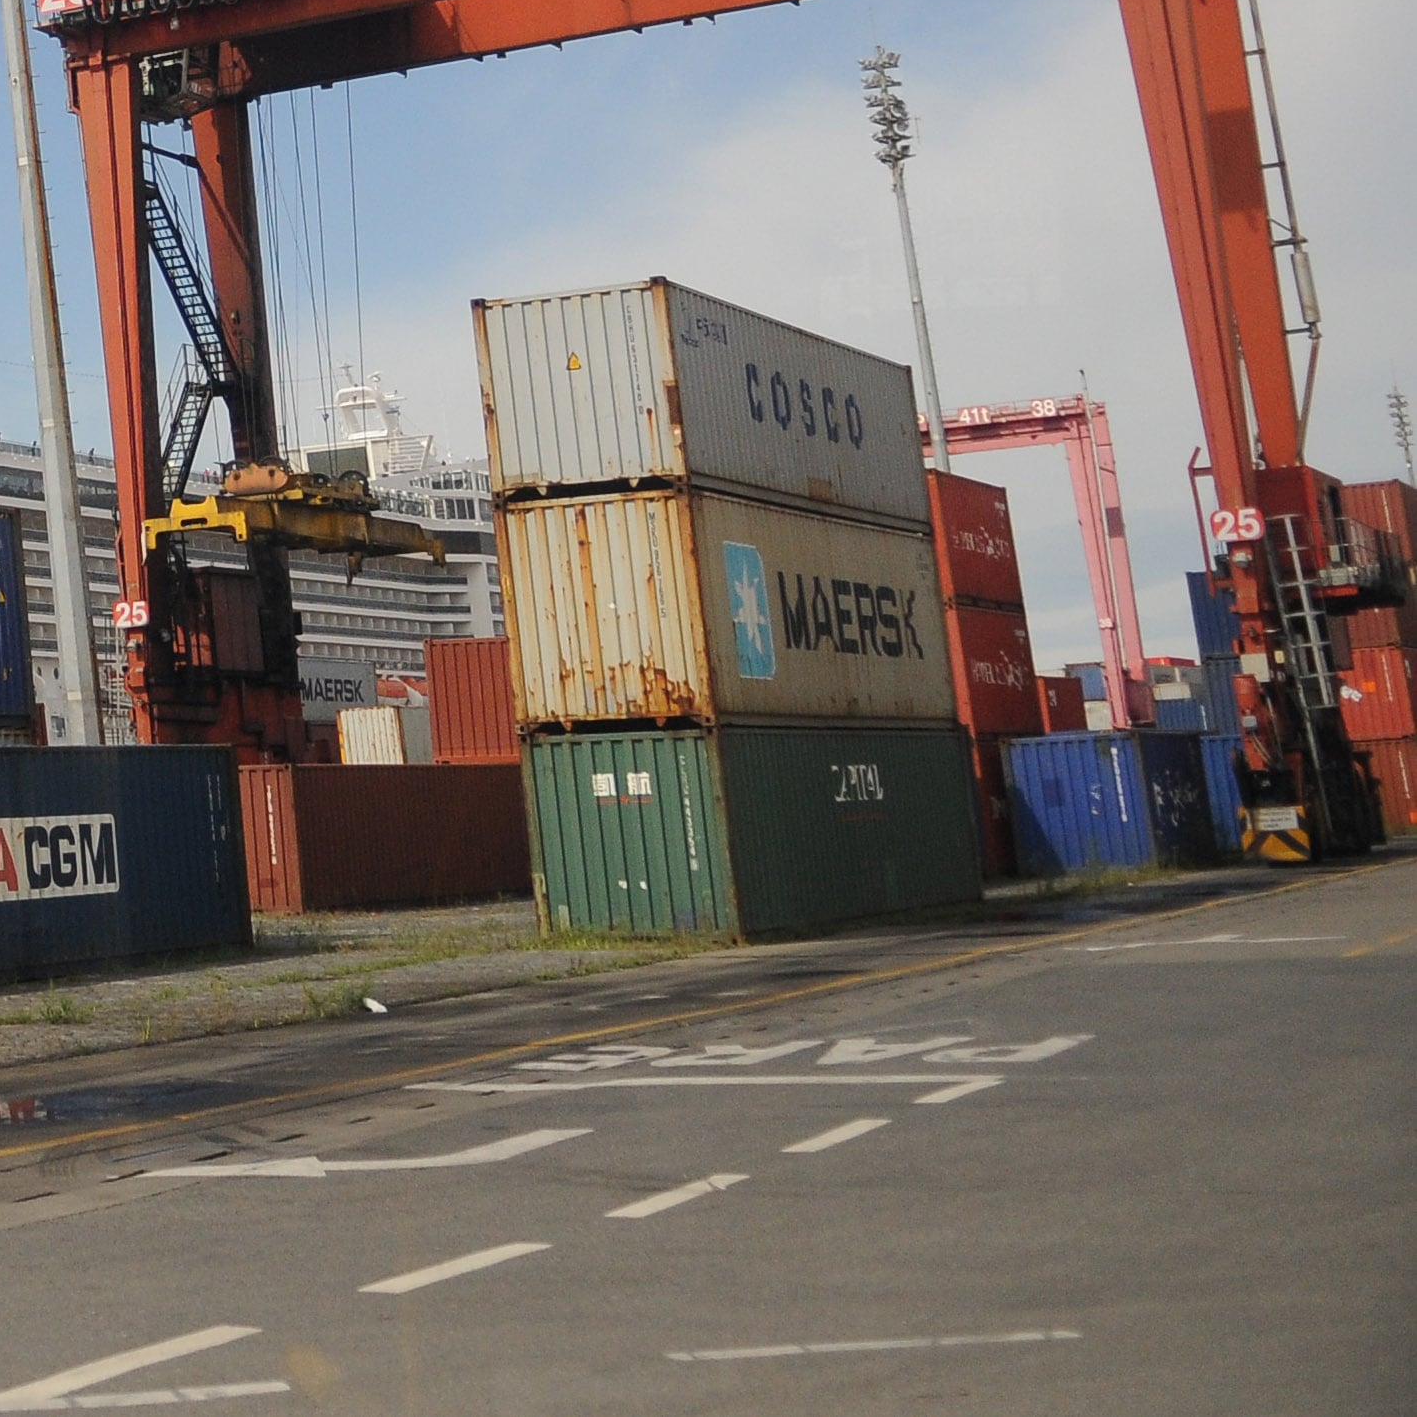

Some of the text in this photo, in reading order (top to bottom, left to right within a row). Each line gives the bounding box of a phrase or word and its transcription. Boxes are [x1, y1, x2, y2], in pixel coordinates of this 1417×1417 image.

[743, 362, 864, 450] COSCO
[959, 407, 989, 424] 41t
[1031, 400, 1056, 417] 38
[1215, 511, 1262, 541] 25
[117, 602, 147, 627] 25
[778, 570, 924, 660] MAERSK
[301, 677, 364, 702] MAERSK
[25, 822, 117, 890] CGM
[513, 1035, 1095, 1073] PARE
